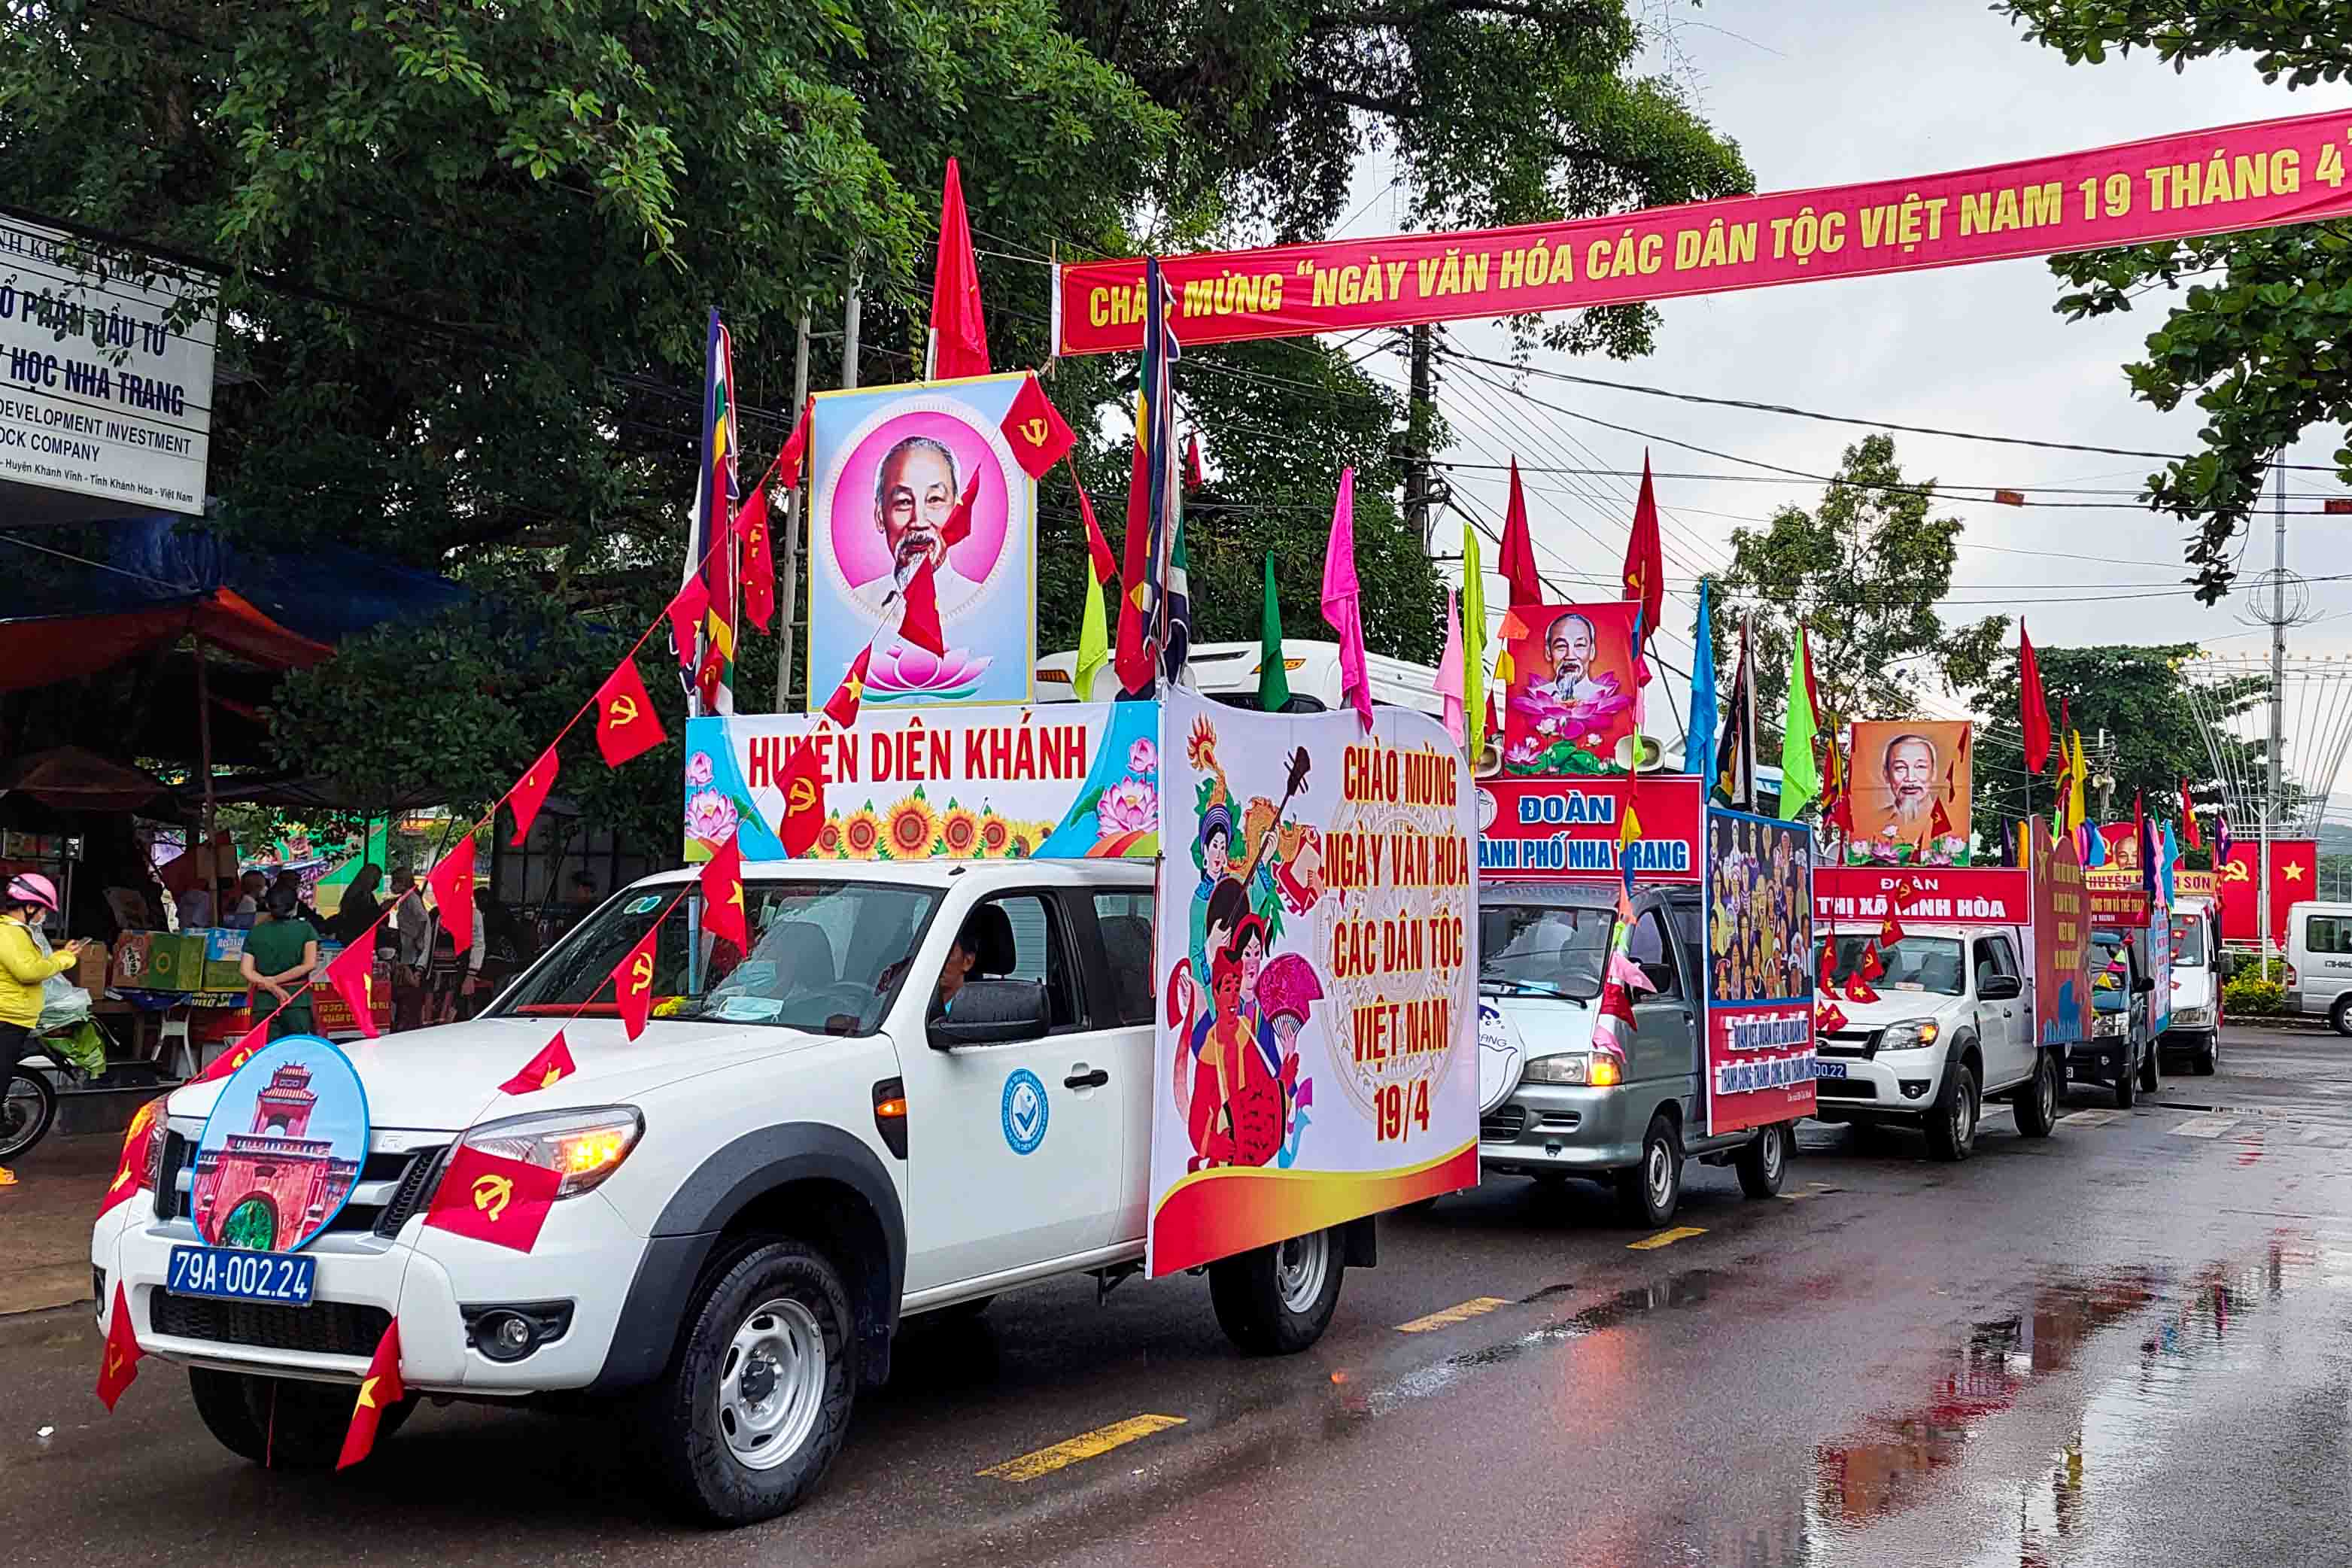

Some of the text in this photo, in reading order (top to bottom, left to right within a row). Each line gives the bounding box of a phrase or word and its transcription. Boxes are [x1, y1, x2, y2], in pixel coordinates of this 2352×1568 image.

[1090, 277, 1172, 327] CHÀ
[1183, 269, 1284, 318] MỪNG
[1418, 247, 1499, 296] VĂN
[1500, 236, 1573, 289] HÓA
[1587, 227, 1664, 278] CÁC
[1676, 217, 1758, 272] DÂN
[1771, 206, 1846, 265] TỘC
[1860, 198, 1948, 251] VIỆT
[1960, 183, 2063, 236] NAM
[2079, 173, 2132, 220] 19
[2145, 149, 2300, 211] THÁNG
[142, 321, 169, 356] TƯ
[11, 347, 184, 416] HỌC NHA TRANG
[31, 433, 100, 462] COMPANY
[106, 421, 191, 454] INVESTMENT
[176, 490, 193, 503] Nam
[871, 716, 951, 782] DIÊN
[965, 713, 1086, 780] KHÁNH
[1343, 735, 1457, 807] CHÀO MỪNG
[1519, 789, 1614, 823] ĐOÀN
[1324, 820, 1469, 889] NGÀY VĂN HÓA
[1522, 831, 1570, 869] PHỐ
[1567, 840, 1614, 870] NHA
[1816, 897, 1855, 919] THỊ
[1859, 894, 1889, 916] XÃ
[1957, 895, 2007, 918] HÒA
[2184, 875, 2211, 889] SƠN
[1332, 907, 1463, 980] CÁC DÂN TỘC
[1353, 995, 1448, 1072] VIỆT NAM
[1373, 1080, 1430, 1143] 19/4
